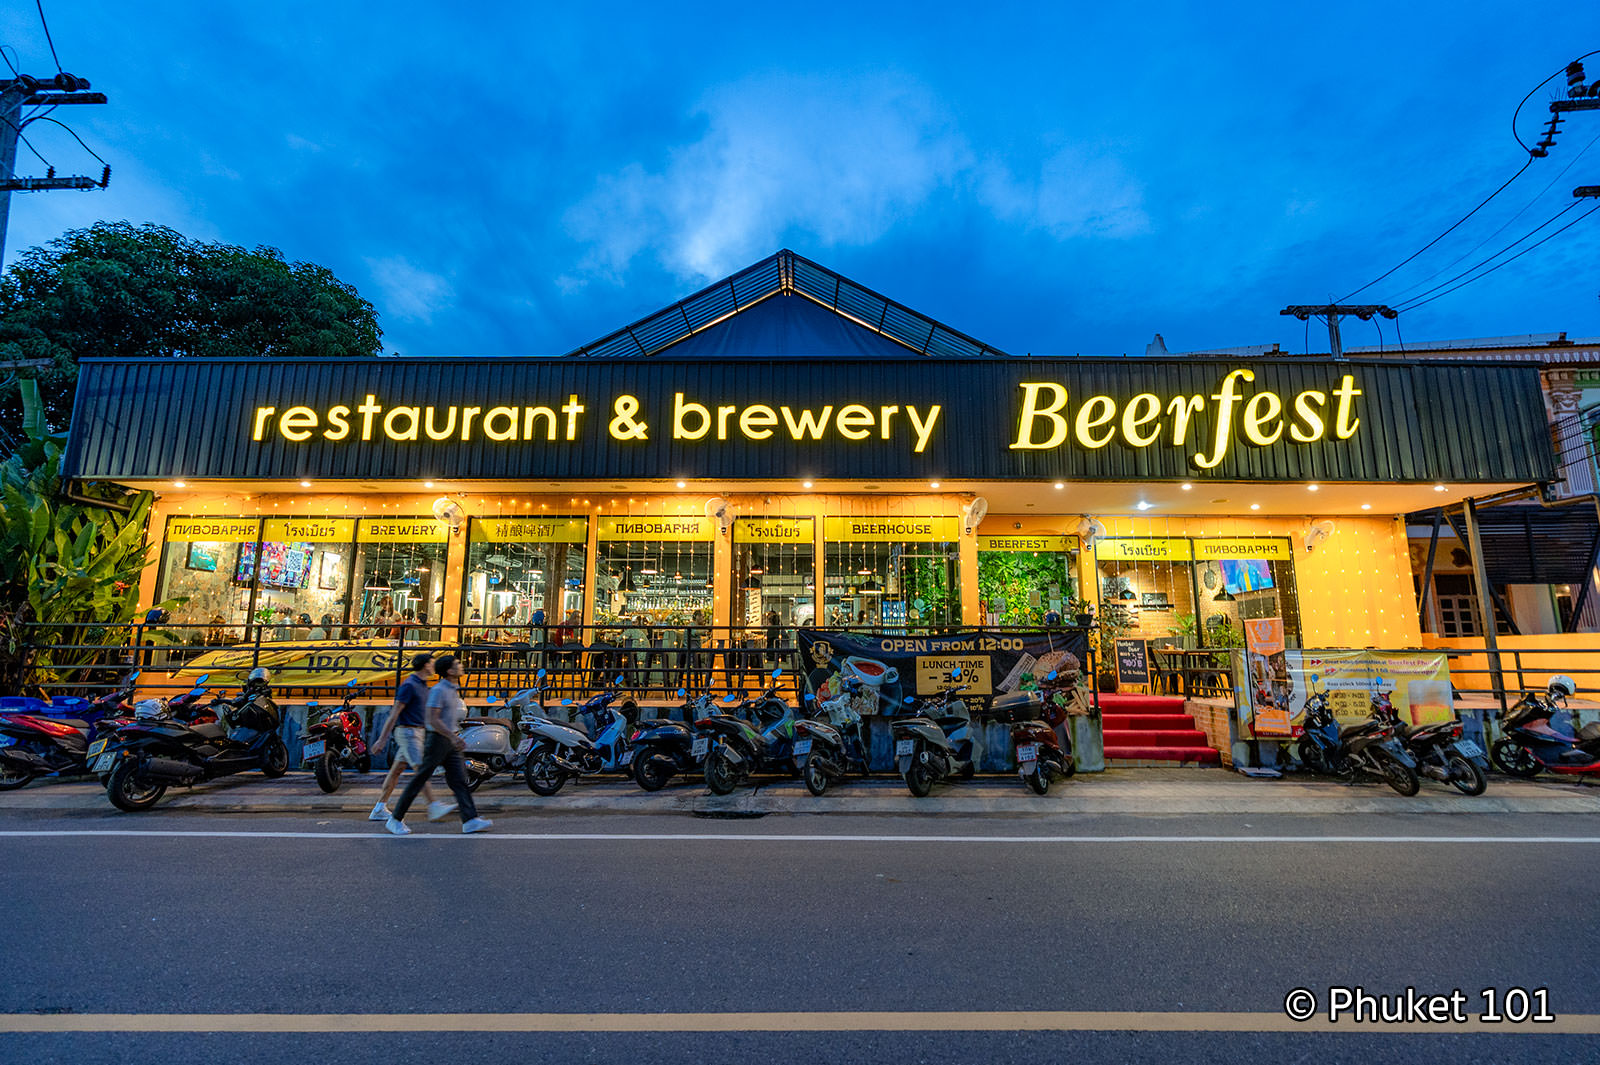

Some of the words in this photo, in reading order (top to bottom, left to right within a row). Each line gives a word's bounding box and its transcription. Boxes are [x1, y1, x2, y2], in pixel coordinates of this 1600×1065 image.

[252, 394, 585, 442] restaurant
[608, 394, 649, 441] &
[672, 392, 942, 453] brewery
[1009, 369, 1363, 470] Beerfest
[173, 524, 256, 535] ПИВОВАРНЯ
[370, 525, 437, 536] BREWERY
[615, 523, 700, 534] ПИВОВАРНЯ
[852, 524, 932, 535] BEERHOUSE
[989, 539, 1048, 549] BEERFEST
[1204, 545, 1279, 555] ПИВОВАРНЯ
[881, 639, 928, 652] OPEN
[931, 640, 975, 652] FROM
[978, 637, 1024, 651] 12:00
[922, 660, 956, 670] LUNCH
[959, 660, 984, 669] TIME
